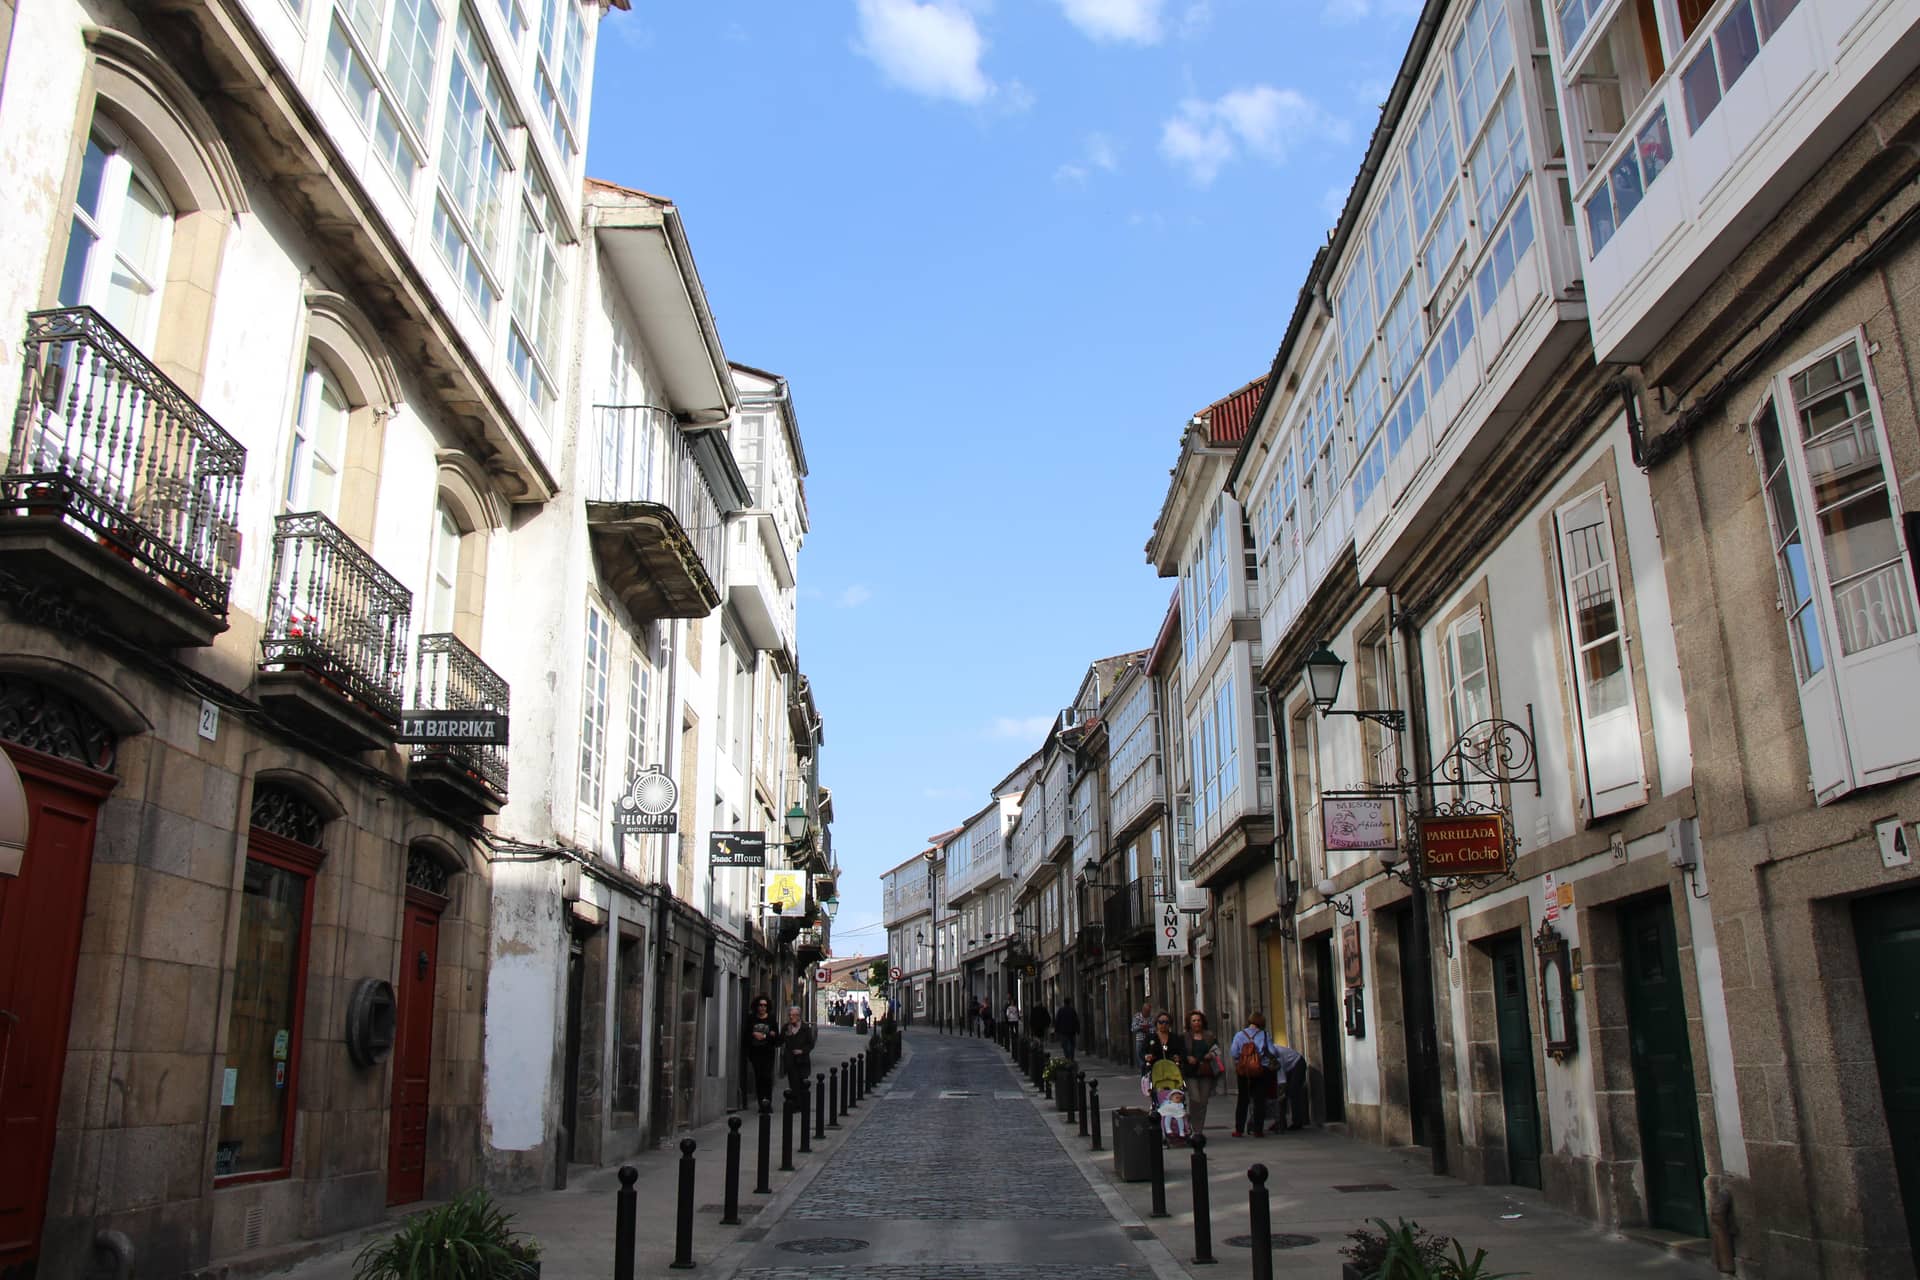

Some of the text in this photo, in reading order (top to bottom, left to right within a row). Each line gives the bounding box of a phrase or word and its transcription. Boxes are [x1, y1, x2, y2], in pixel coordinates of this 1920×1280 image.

[203, 710, 215, 733] 21
[403, 720, 495, 737] LA BARRIKA
[621, 814, 675, 825] VELOCIPEDO
[1426, 827, 1496, 841] PARRILLADA
[1894, 826, 1908, 857] 4
[1330, 839, 1393, 848] RESTAURANTE
[734, 853, 762, 863] Moure
[1427, 845, 1500, 864] San Clodio
[1164, 904, 1178, 950] AMOA
